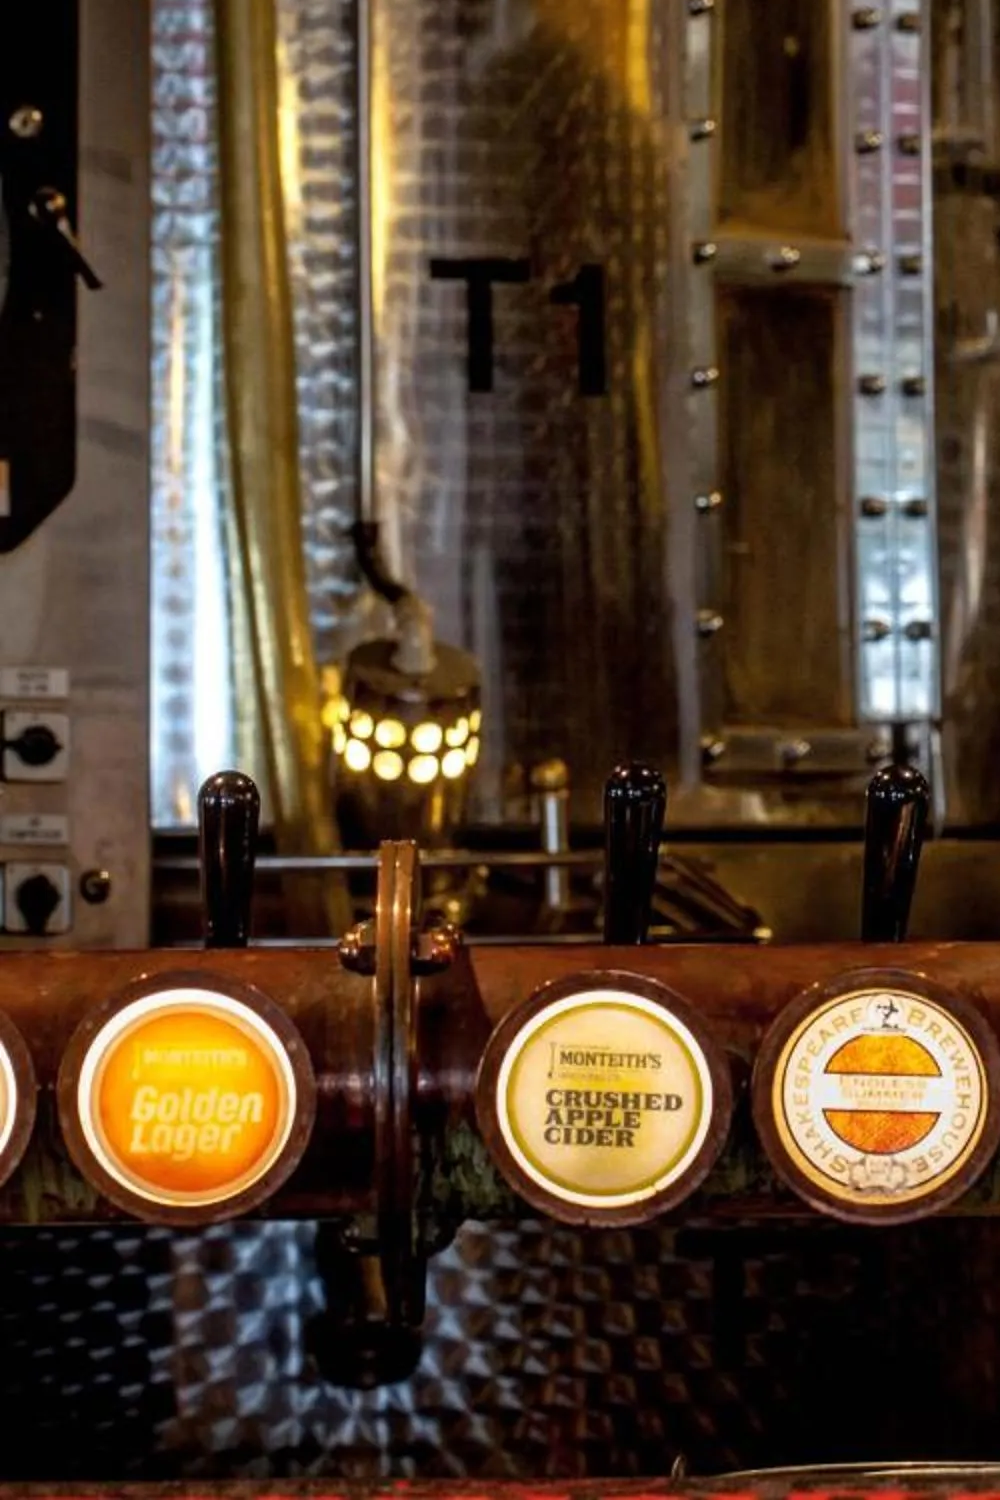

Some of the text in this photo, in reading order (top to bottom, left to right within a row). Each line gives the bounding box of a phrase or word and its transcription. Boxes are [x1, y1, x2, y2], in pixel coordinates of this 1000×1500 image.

[429, 259, 605, 396] T1
[559, 1050, 662, 1070] MONTEITH'S
[131, 1085, 264, 1123] Golden
[546, 1089, 683, 1111] CRUSHED
[793, 1007, 866, 1174] SHAKESPEARE
[544, 1109, 641, 1129] APPLE
[131, 1123, 242, 1161] Lager
[544, 1127, 635, 1147] CIDER
